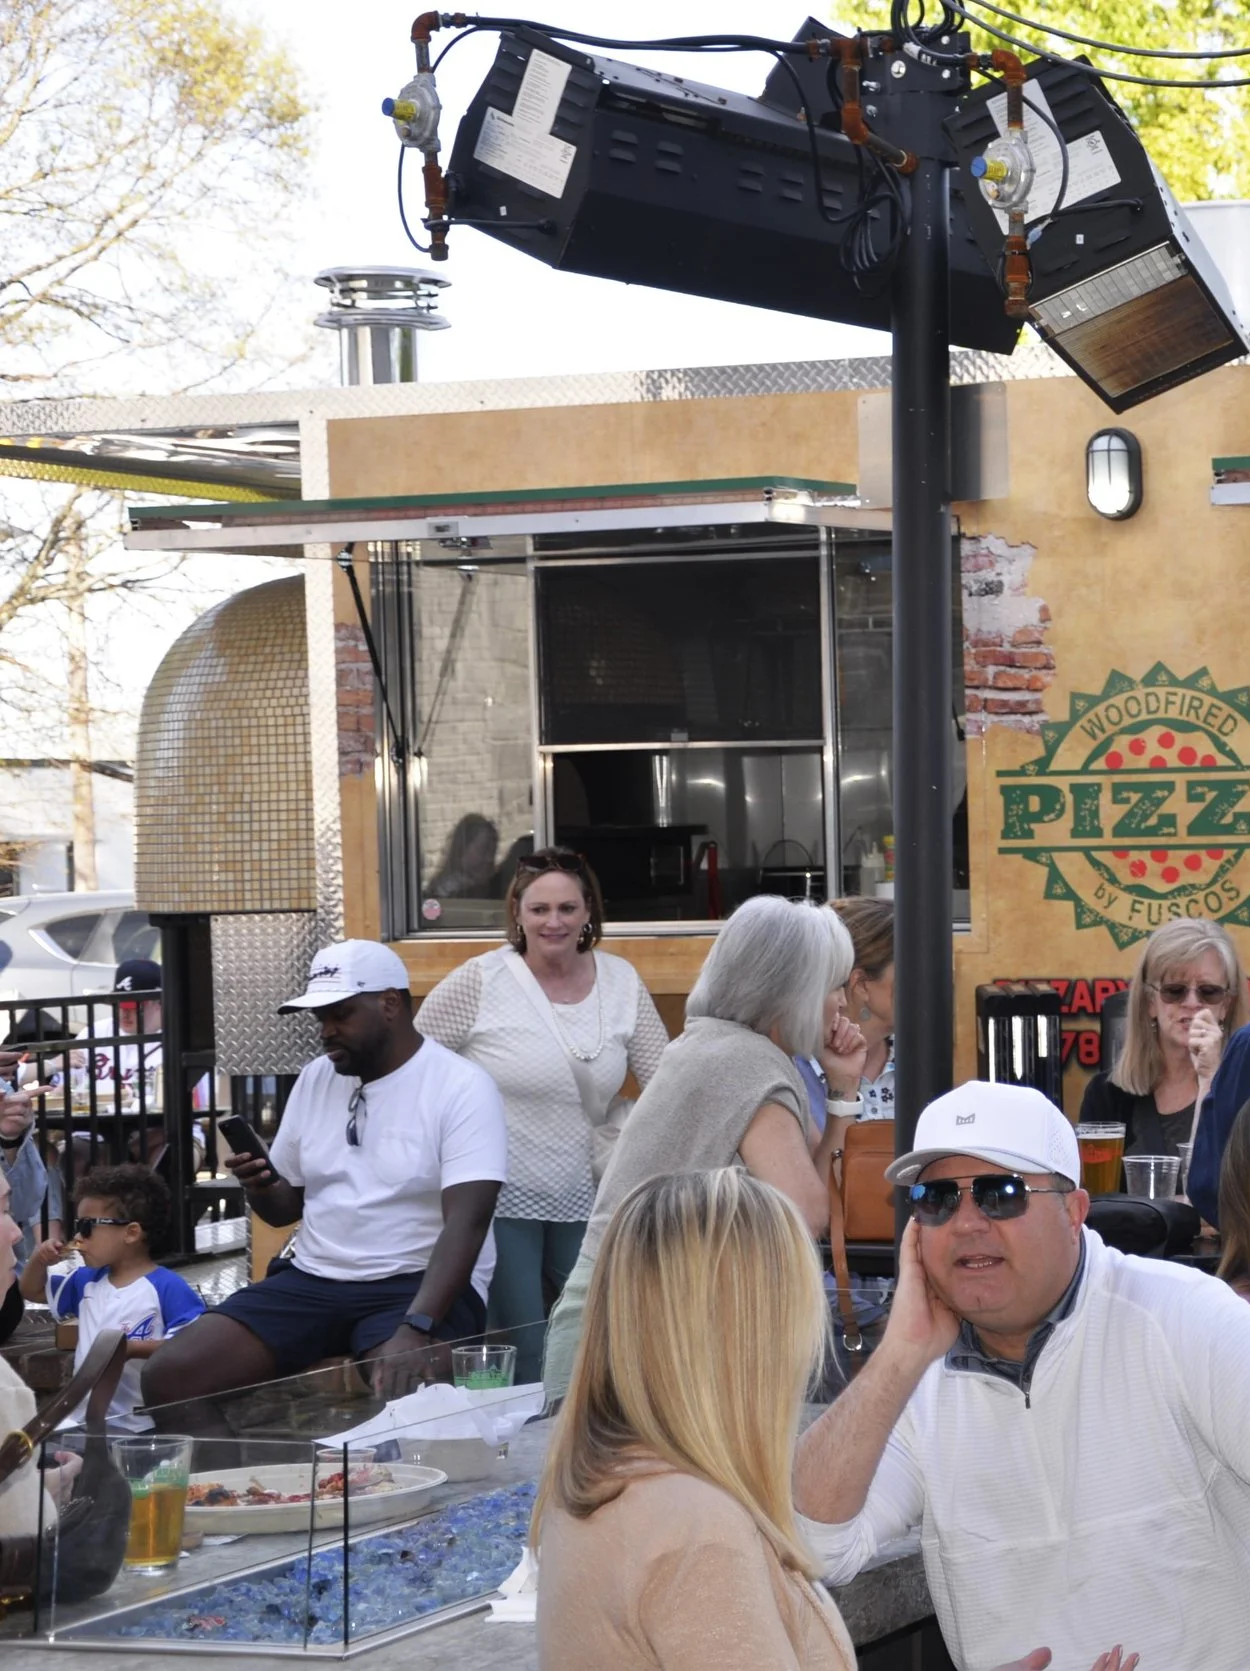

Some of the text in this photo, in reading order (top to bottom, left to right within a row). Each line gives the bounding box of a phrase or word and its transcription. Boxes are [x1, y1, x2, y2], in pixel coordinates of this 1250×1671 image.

[1080, 691, 1239, 742] WOODFIRED
[1093, 880, 1241, 926] by FUSCOS
[1060, 1031, 1100, 1066] 78
